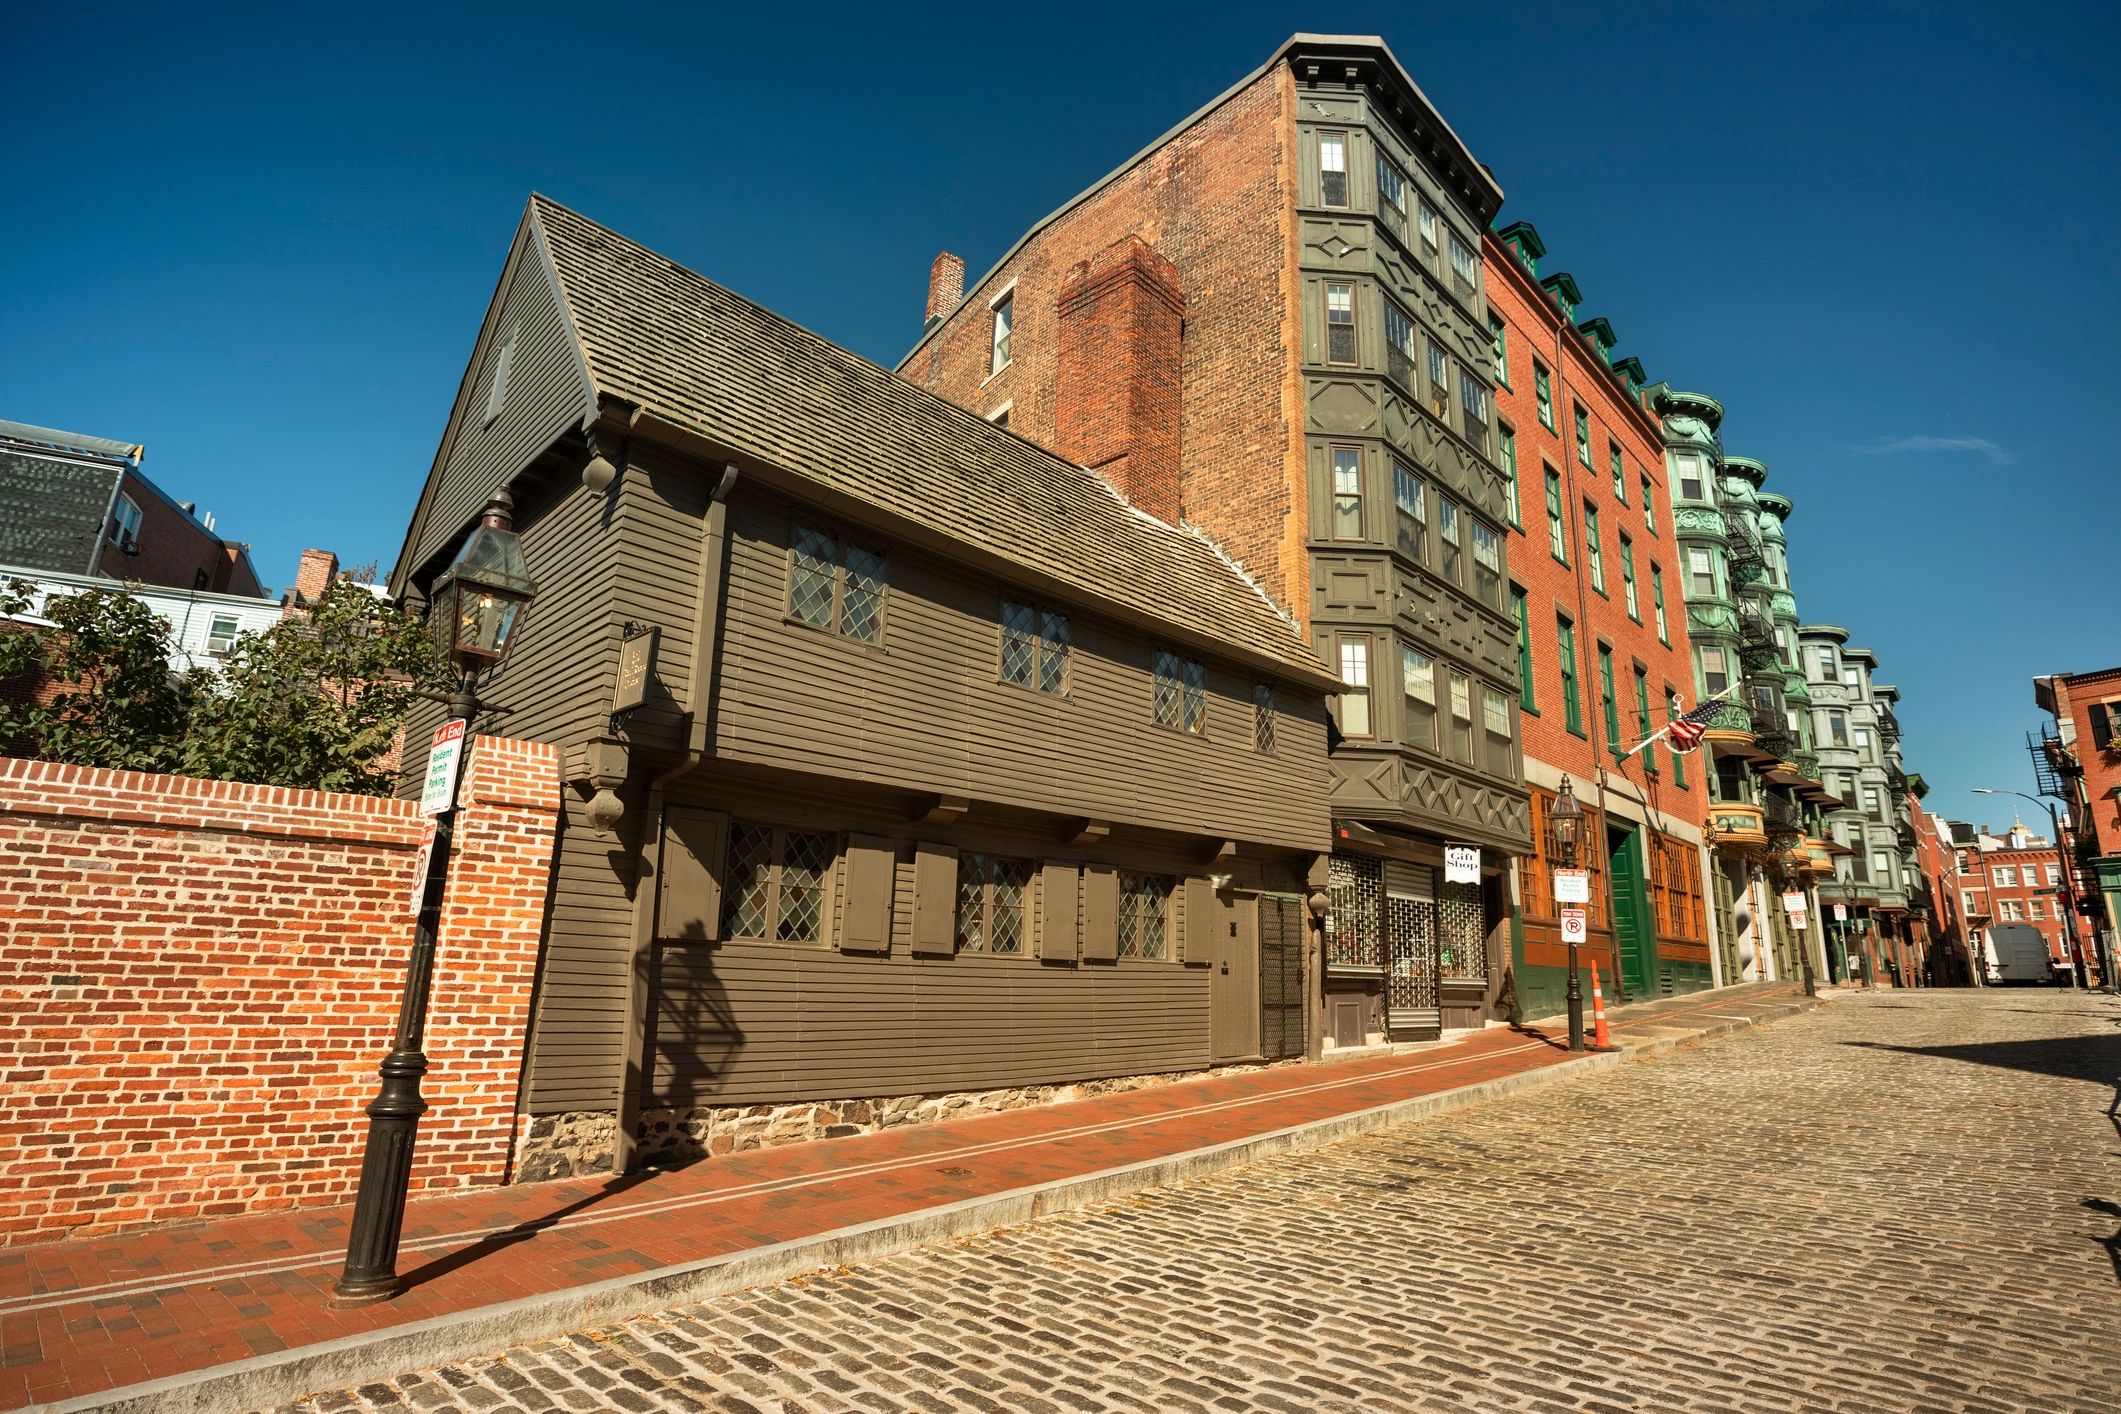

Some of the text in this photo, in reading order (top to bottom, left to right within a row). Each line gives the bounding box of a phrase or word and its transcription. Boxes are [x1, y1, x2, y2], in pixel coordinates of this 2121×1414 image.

[447, 723, 463, 739] End
[432, 748, 453, 763] Resident
[431, 762, 447, 775] Permit
[428, 777, 446, 789] Parking
[1450, 852, 1473, 861] Gift
[1447, 860, 1478, 871] Shop
